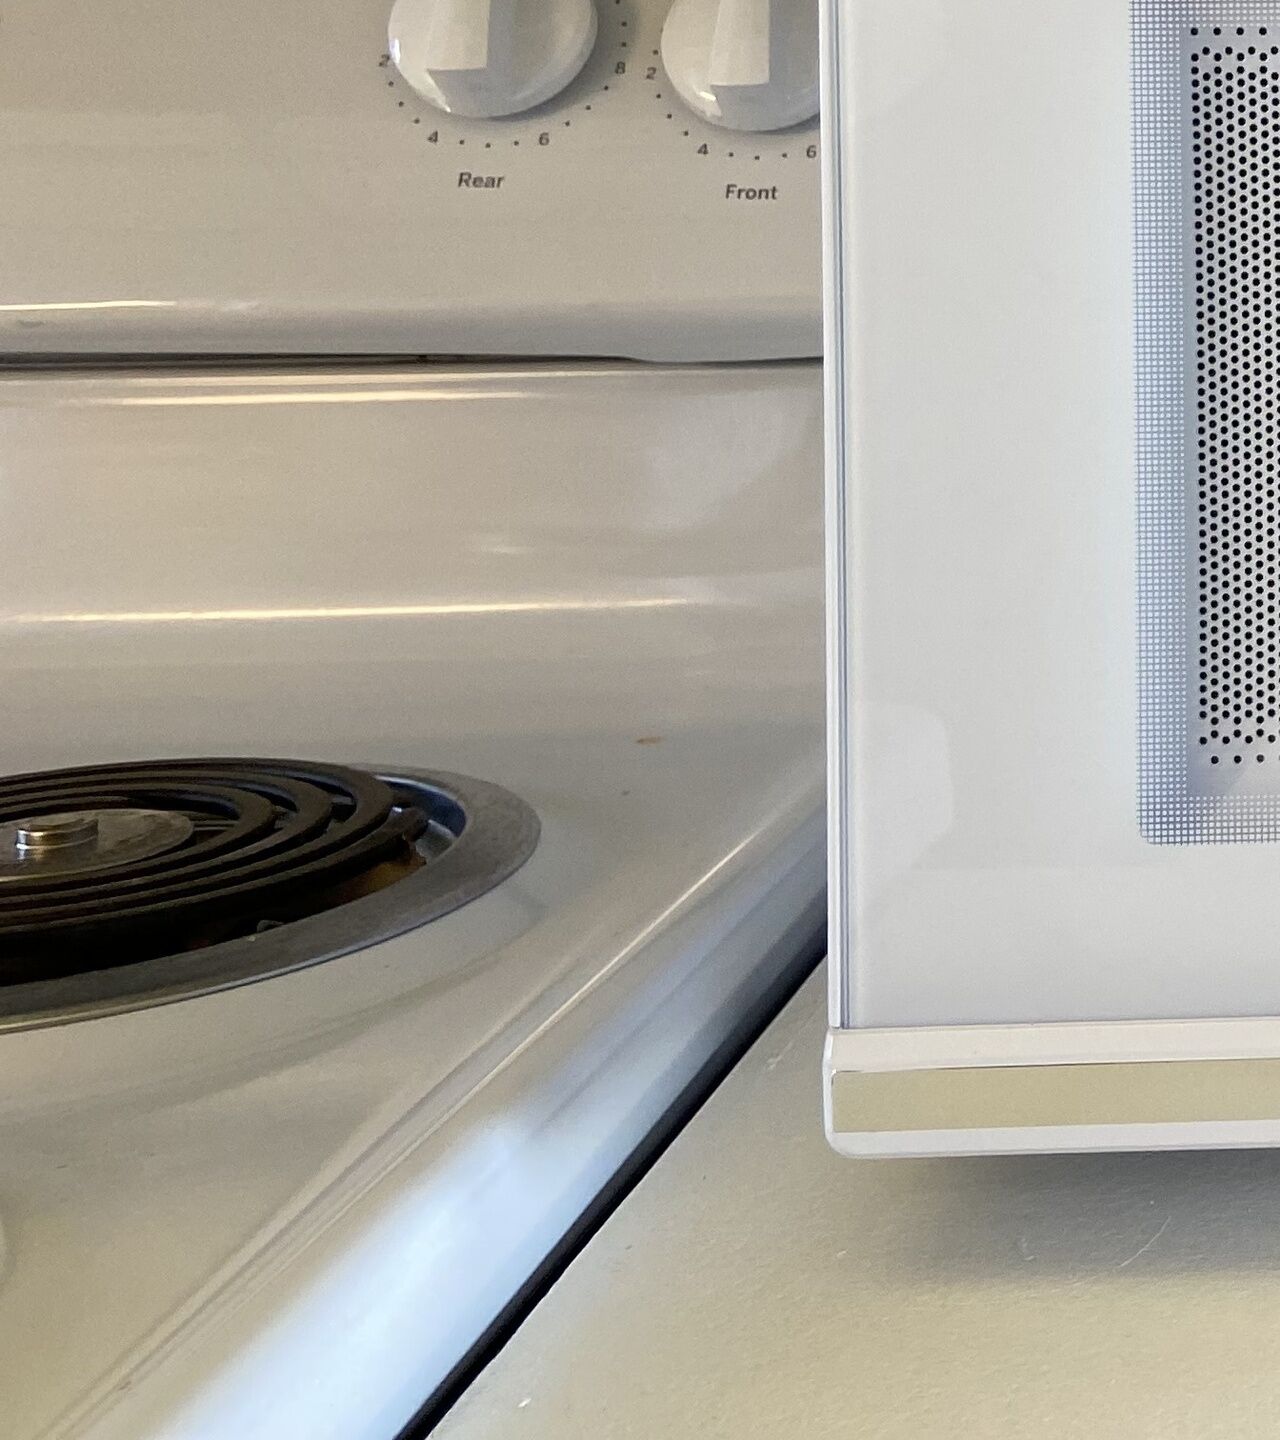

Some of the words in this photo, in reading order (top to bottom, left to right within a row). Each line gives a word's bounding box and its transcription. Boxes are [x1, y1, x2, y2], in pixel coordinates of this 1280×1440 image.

[615, 61, 626, 74] 8
[646, 66, 657, 80] 2
[427, 131, 438, 144] 4
[539, 132, 550, 146] 6
[697, 143, 709, 155] 4
[806, 144, 817, 159] 6
[458, 171, 505, 188] Rear
[725, 184, 778, 200] Front
